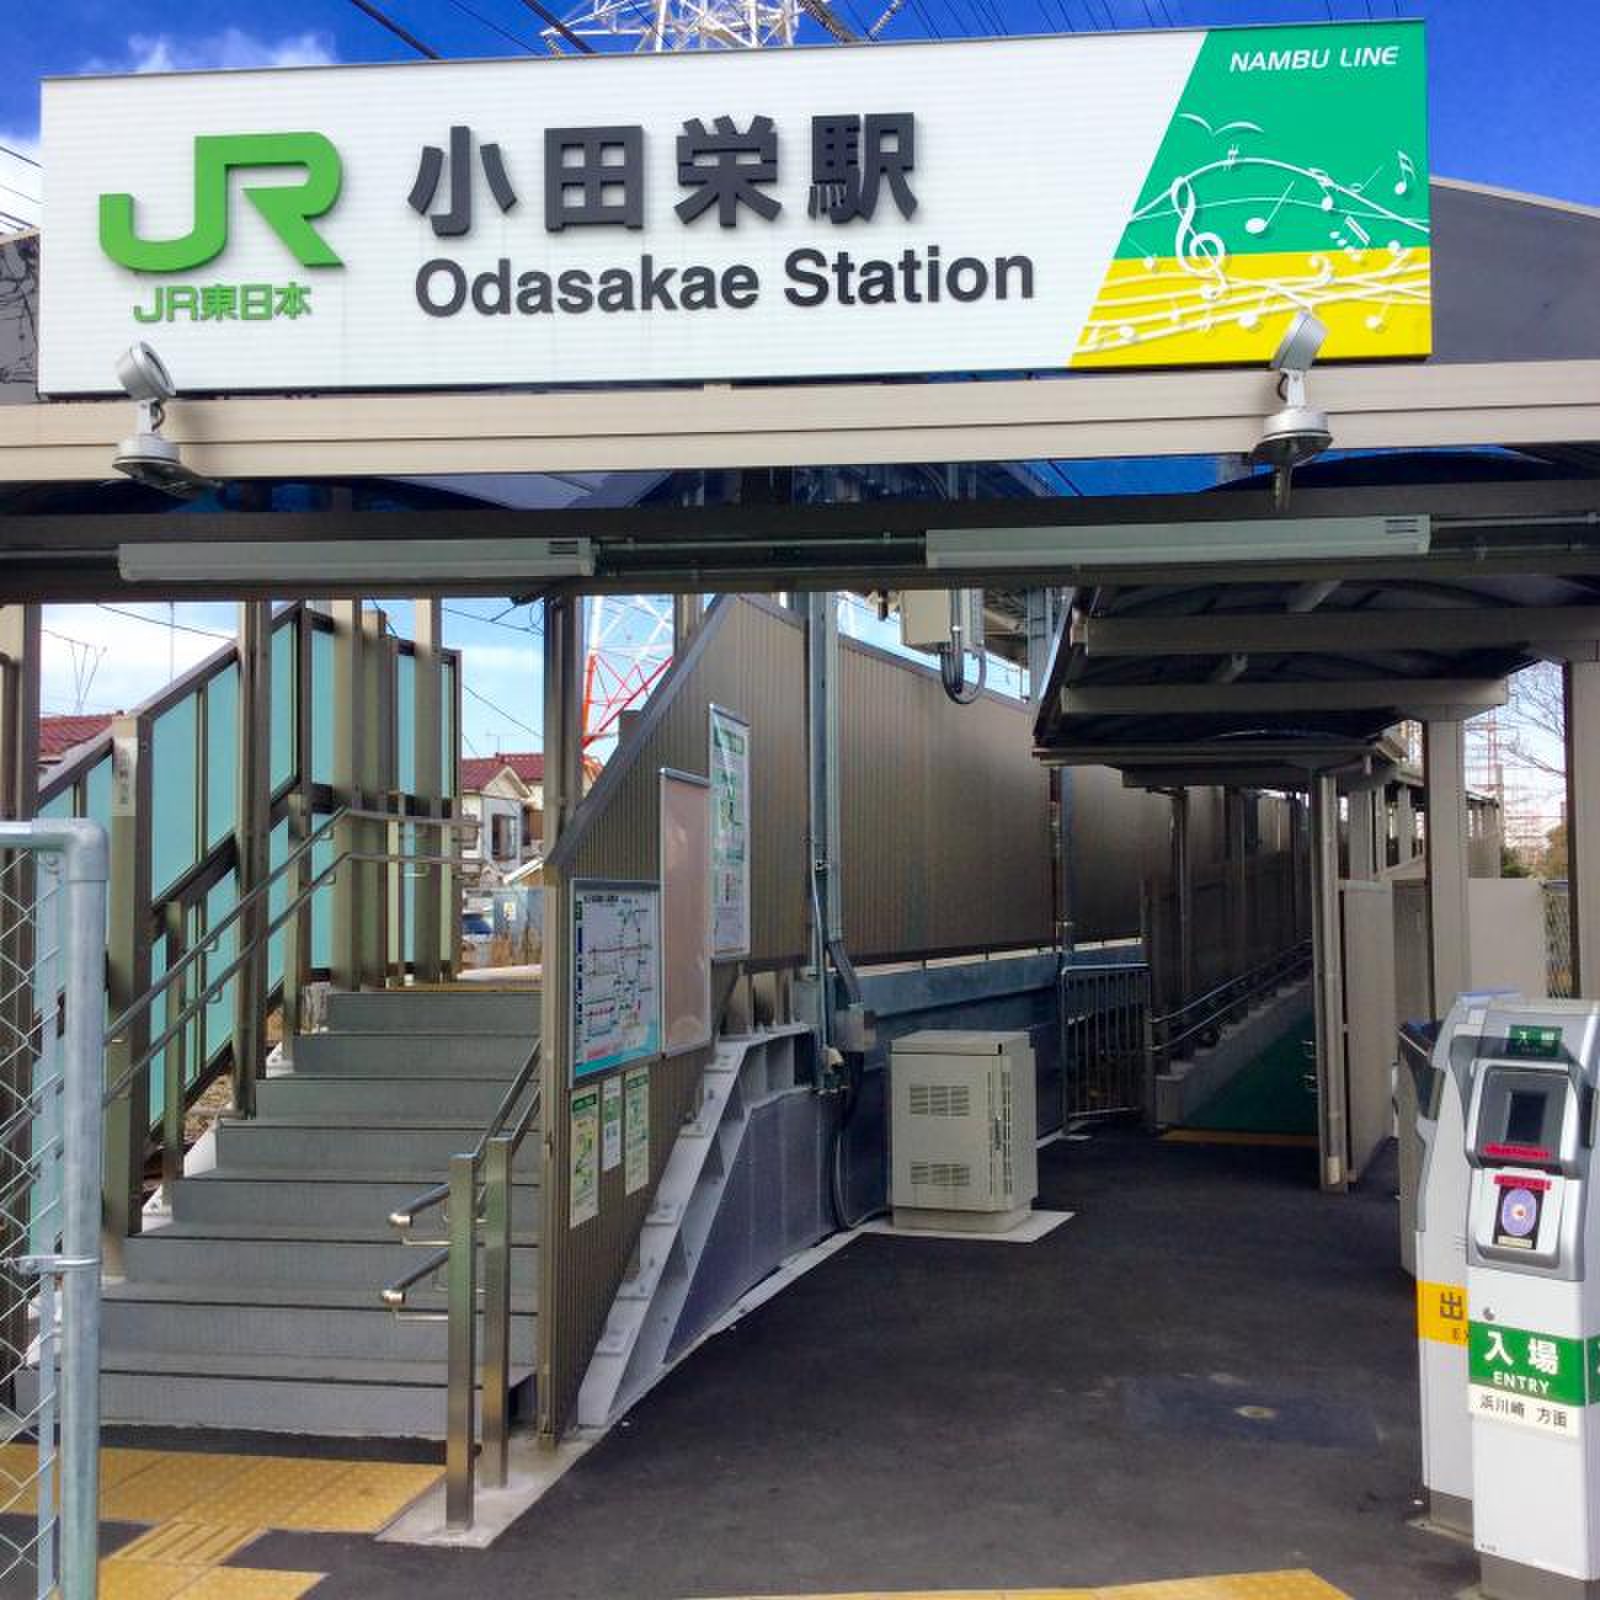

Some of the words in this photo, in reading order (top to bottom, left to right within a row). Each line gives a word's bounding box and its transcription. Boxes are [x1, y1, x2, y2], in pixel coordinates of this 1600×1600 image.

[1229, 47, 1331, 73] NAMBU
[1339, 45, 1400, 68] LINE
[406, 111, 919, 237] 小田栄駅
[98, 130, 345, 274] JR
[133, 281, 312, 324] JR東日本
[414, 254, 760, 319] Odasakae
[783, 245, 1035, 308] Station
[1439, 1290, 1464, 1321] 出
[1483, 1329, 1560, 1376] 入場
[1492, 1371, 1550, 1395] ENTRY
